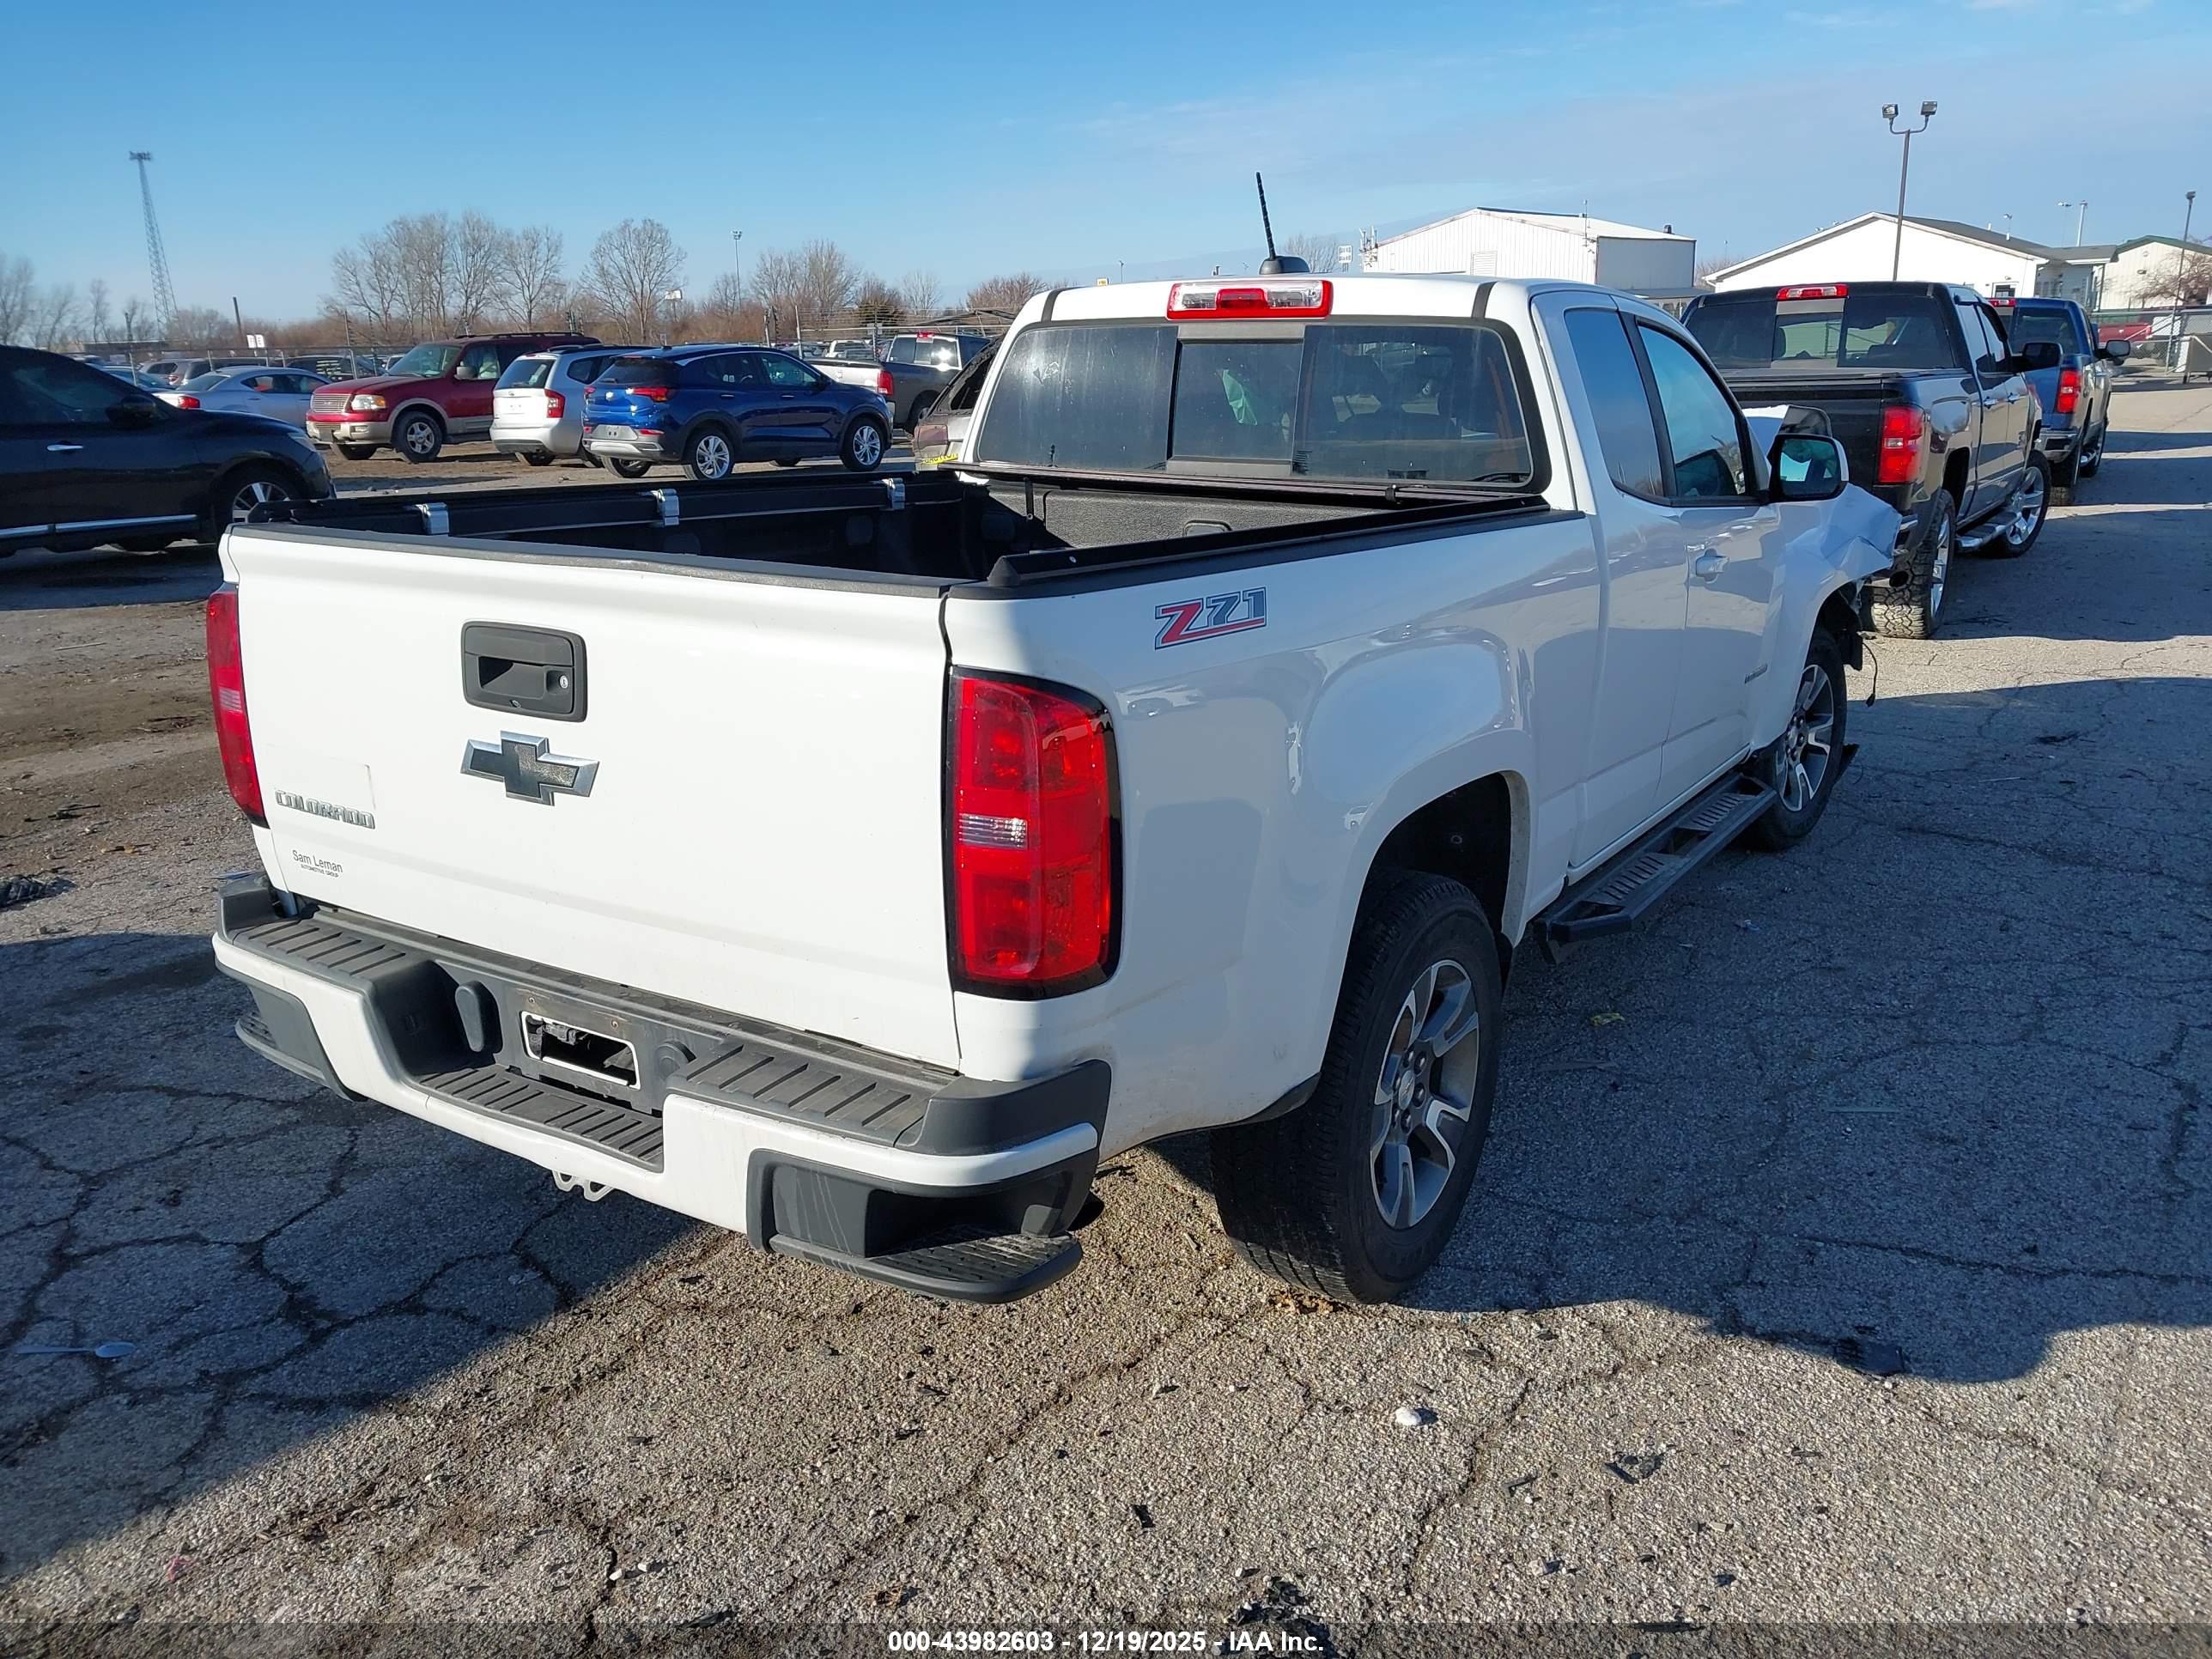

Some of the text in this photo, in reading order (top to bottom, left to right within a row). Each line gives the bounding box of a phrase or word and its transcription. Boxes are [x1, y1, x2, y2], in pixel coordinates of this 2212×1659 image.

[1155, 586, 1267, 650] Z71
[275, 790, 376, 830] COLORADO
[292, 849, 343, 873] Sam Leman
